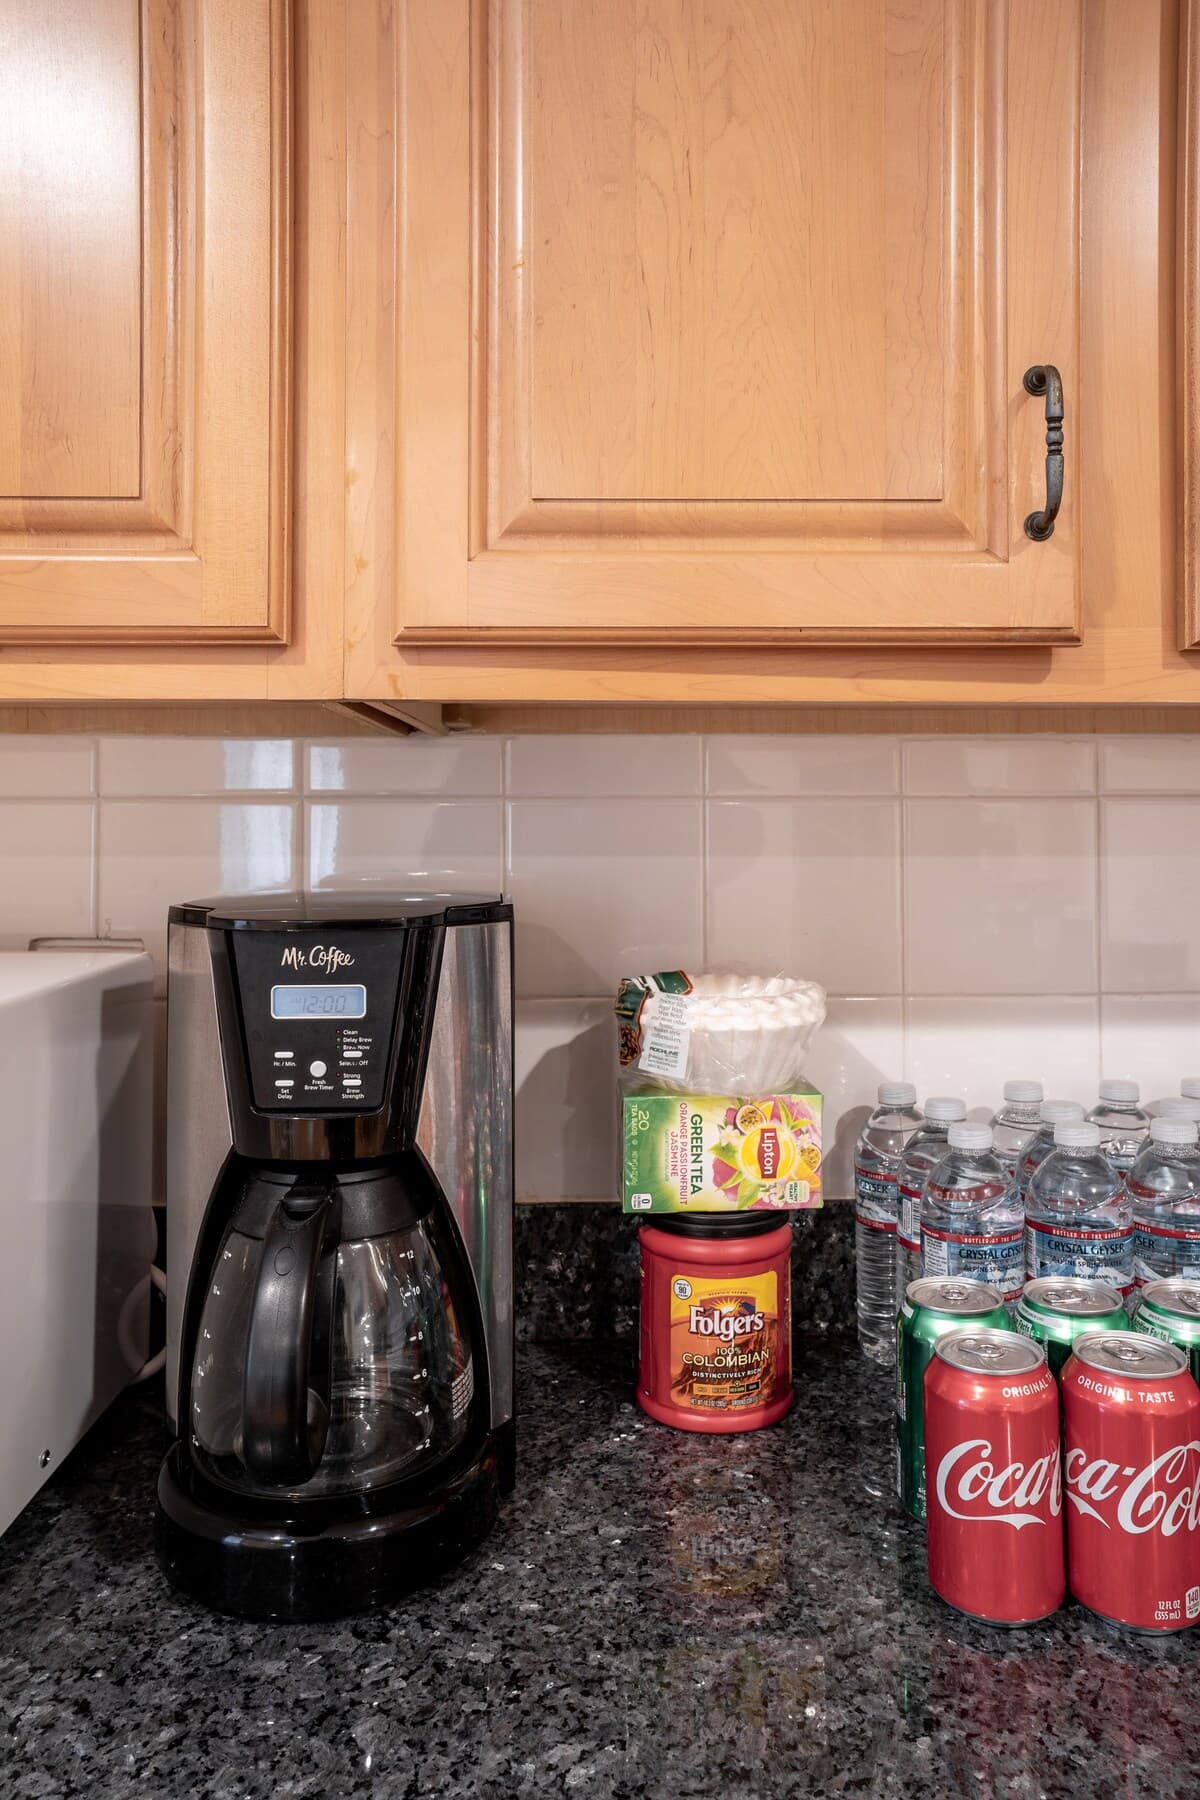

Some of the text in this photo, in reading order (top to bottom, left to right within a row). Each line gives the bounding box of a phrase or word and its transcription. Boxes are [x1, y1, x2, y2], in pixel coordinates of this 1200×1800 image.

[281, 945, 355, 974] Mr. Coffee
[302, 996, 346, 1014] 12:00
[638, 1110, 649, 1130] 20
[670, 1131, 678, 1177] JASMINE
[679, 1103, 688, 1205] ORANGE PASSIONFRUIT
[690, 1114, 703, 1194] GREEN TEA
[762, 1132, 776, 1174] Lipton
[1052, 1229, 1077, 1237] BOTTLED
[406, 1250, 414, 1260] 12
[959, 1248, 1000, 1260] CRYSTAL
[1047, 1239, 1124, 1255] CRYSTAL GEYSER
[413, 1286, 420, 1295] 10
[678, 1286, 687, 1294] 90
[689, 1305, 765, 1341] Folgers
[682, 1349, 769, 1367] COLOMBIAN
[716, 1347, 741, 1355] 100%
[422, 1368, 427, 1378] 6
[1002, 1378, 1048, 1398] ORIGINAL
[1077, 1375, 1175, 1404] ORIGINAL TASTE
[424, 1438, 431, 1448] 2
[1158, 1601, 1165, 1610] 12
[1166, 1601, 1172, 1610] FL
[1173, 1600, 1180, 1609] OZ
[1155, 1611, 1168, 1620] (355
